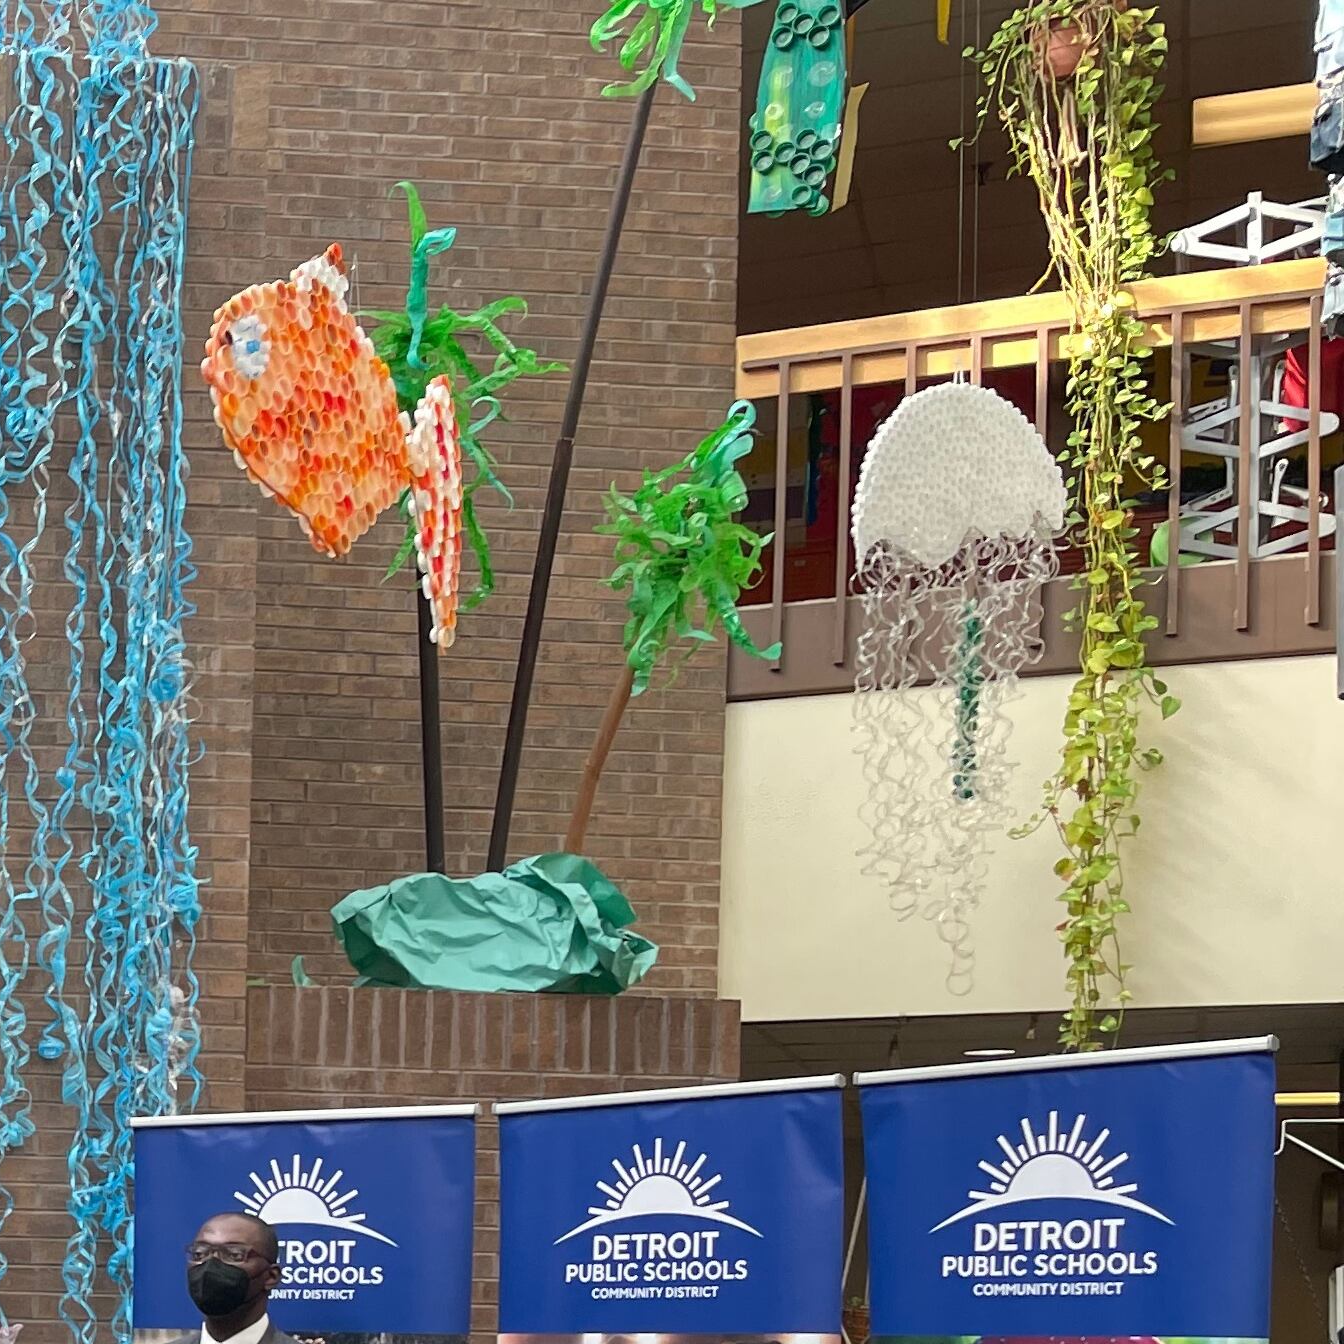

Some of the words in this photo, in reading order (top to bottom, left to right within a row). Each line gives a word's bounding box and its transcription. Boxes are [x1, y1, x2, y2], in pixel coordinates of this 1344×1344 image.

[592, 1231, 720, 1261] DETROIT
[974, 1218, 1125, 1252] DETROIT
[276, 1240, 356, 1265] TROIT
[280, 1266, 384, 1285] SCHOOLS
[565, 1263, 639, 1283] PUBLIC
[643, 1260, 748, 1281] SCHOOLS
[941, 1254, 1027, 1278] PUBLIC
[1033, 1251, 1158, 1276] SCHOOLS
[303, 1288, 355, 1300] DISTRICT
[591, 1287, 663, 1300] COMMUNITY
[665, 1285, 720, 1299] DISTRICT
[972, 1282, 1058, 1298] COMMUNITY
[1061, 1281, 1125, 1296] DISTRICT
